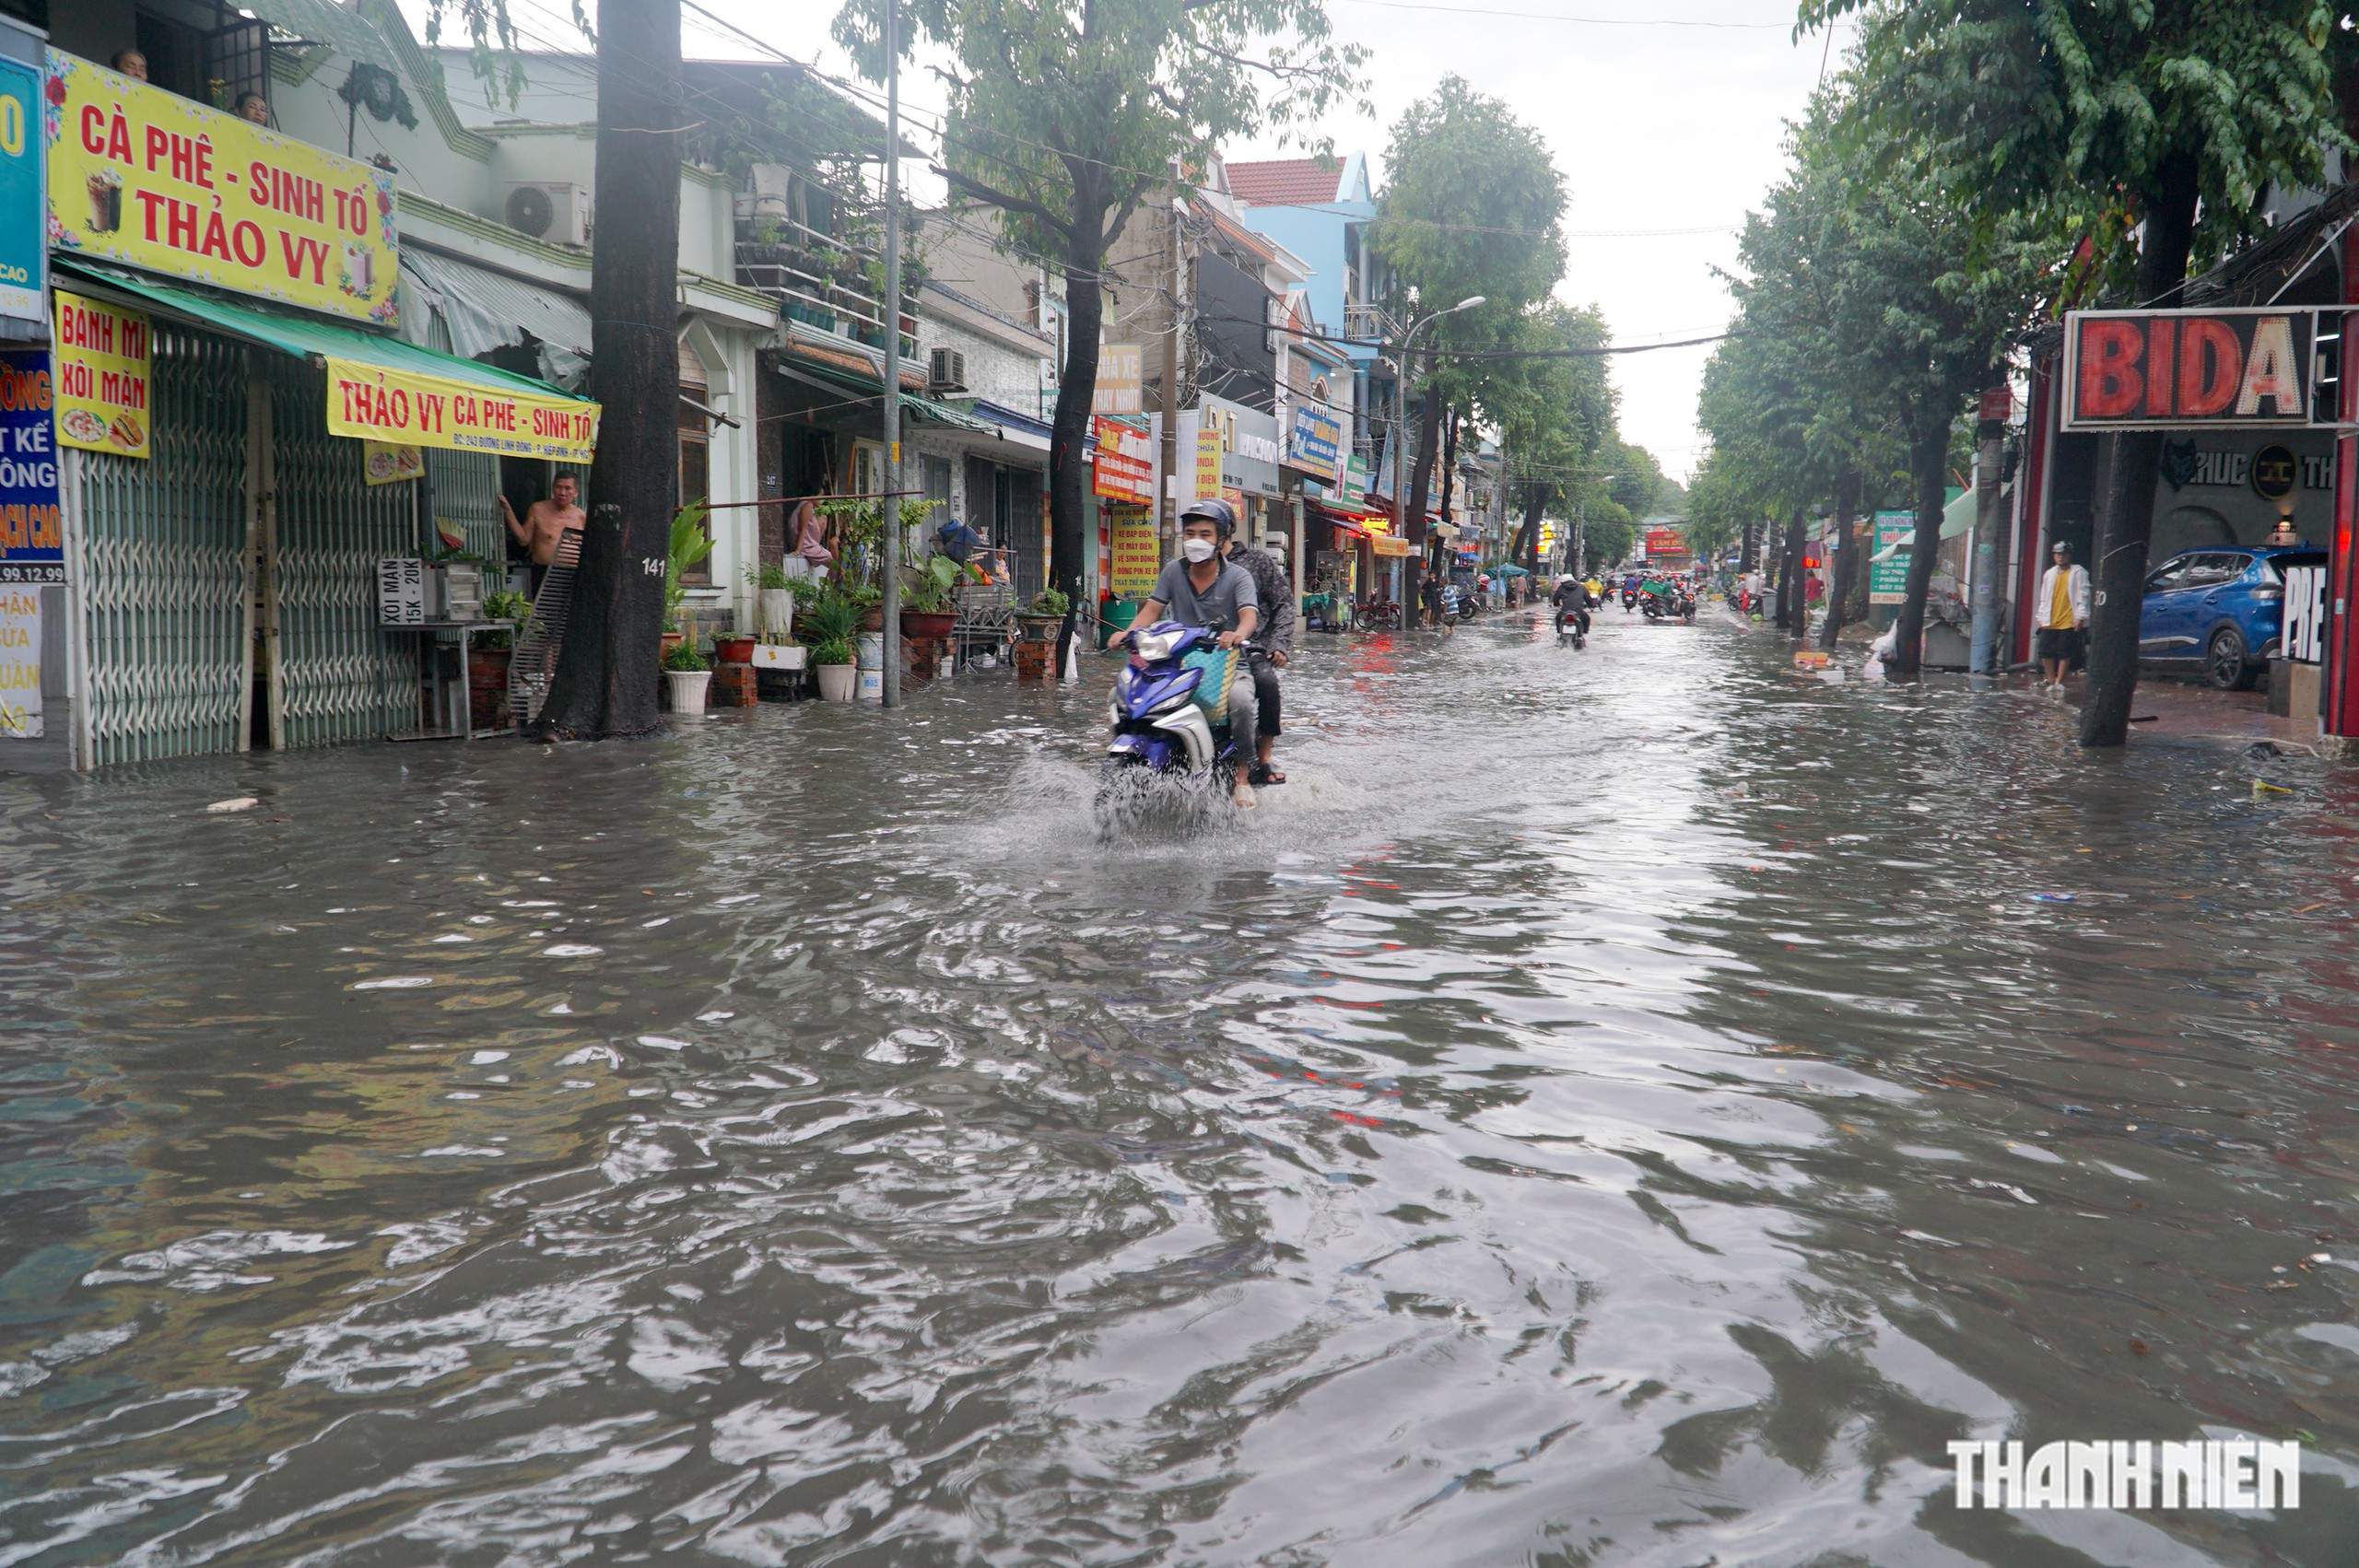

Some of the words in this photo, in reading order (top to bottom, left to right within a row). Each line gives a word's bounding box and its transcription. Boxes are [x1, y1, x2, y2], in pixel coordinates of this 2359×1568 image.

[80, 103, 134, 166] CÀ
[146, 123, 215, 191] PHÊ
[250, 160, 325, 225] SINH
[334, 184, 369, 237] TỐ
[135, 189, 267, 269] THẢO
[278, 228, 332, 287] VY
[63, 299, 113, 354] BÁNH
[121, 315, 146, 361] MÌ
[1122, 355, 1138, 380] XE
[2079, 317, 2304, 418] BIDA
[62, 358, 93, 400] XÔI
[101, 369, 145, 414] MẶN
[1094, 389, 1113, 411] THAY
[338, 371, 409, 428] THẢO
[415, 392, 445, 434] VY
[453, 390, 478, 427] CÀ
[483, 397, 516, 431] PHÊ
[533, 408, 570, 439] SINH
[573, 407, 591, 441] TỐ
[15, 419, 50, 452] KẾ
[465, 435, 478, 446] 243
[501, 439, 515, 451] LINH
[29, 504, 62, 548] CAO
[380, 560, 402, 592] MẶN
[404, 561, 419, 584] 20K
[642, 557, 665, 578] 141
[380, 600, 400, 623] XÔI
[405, 601, 421, 623] 15K
[2282, 567, 2327, 662] PRE
